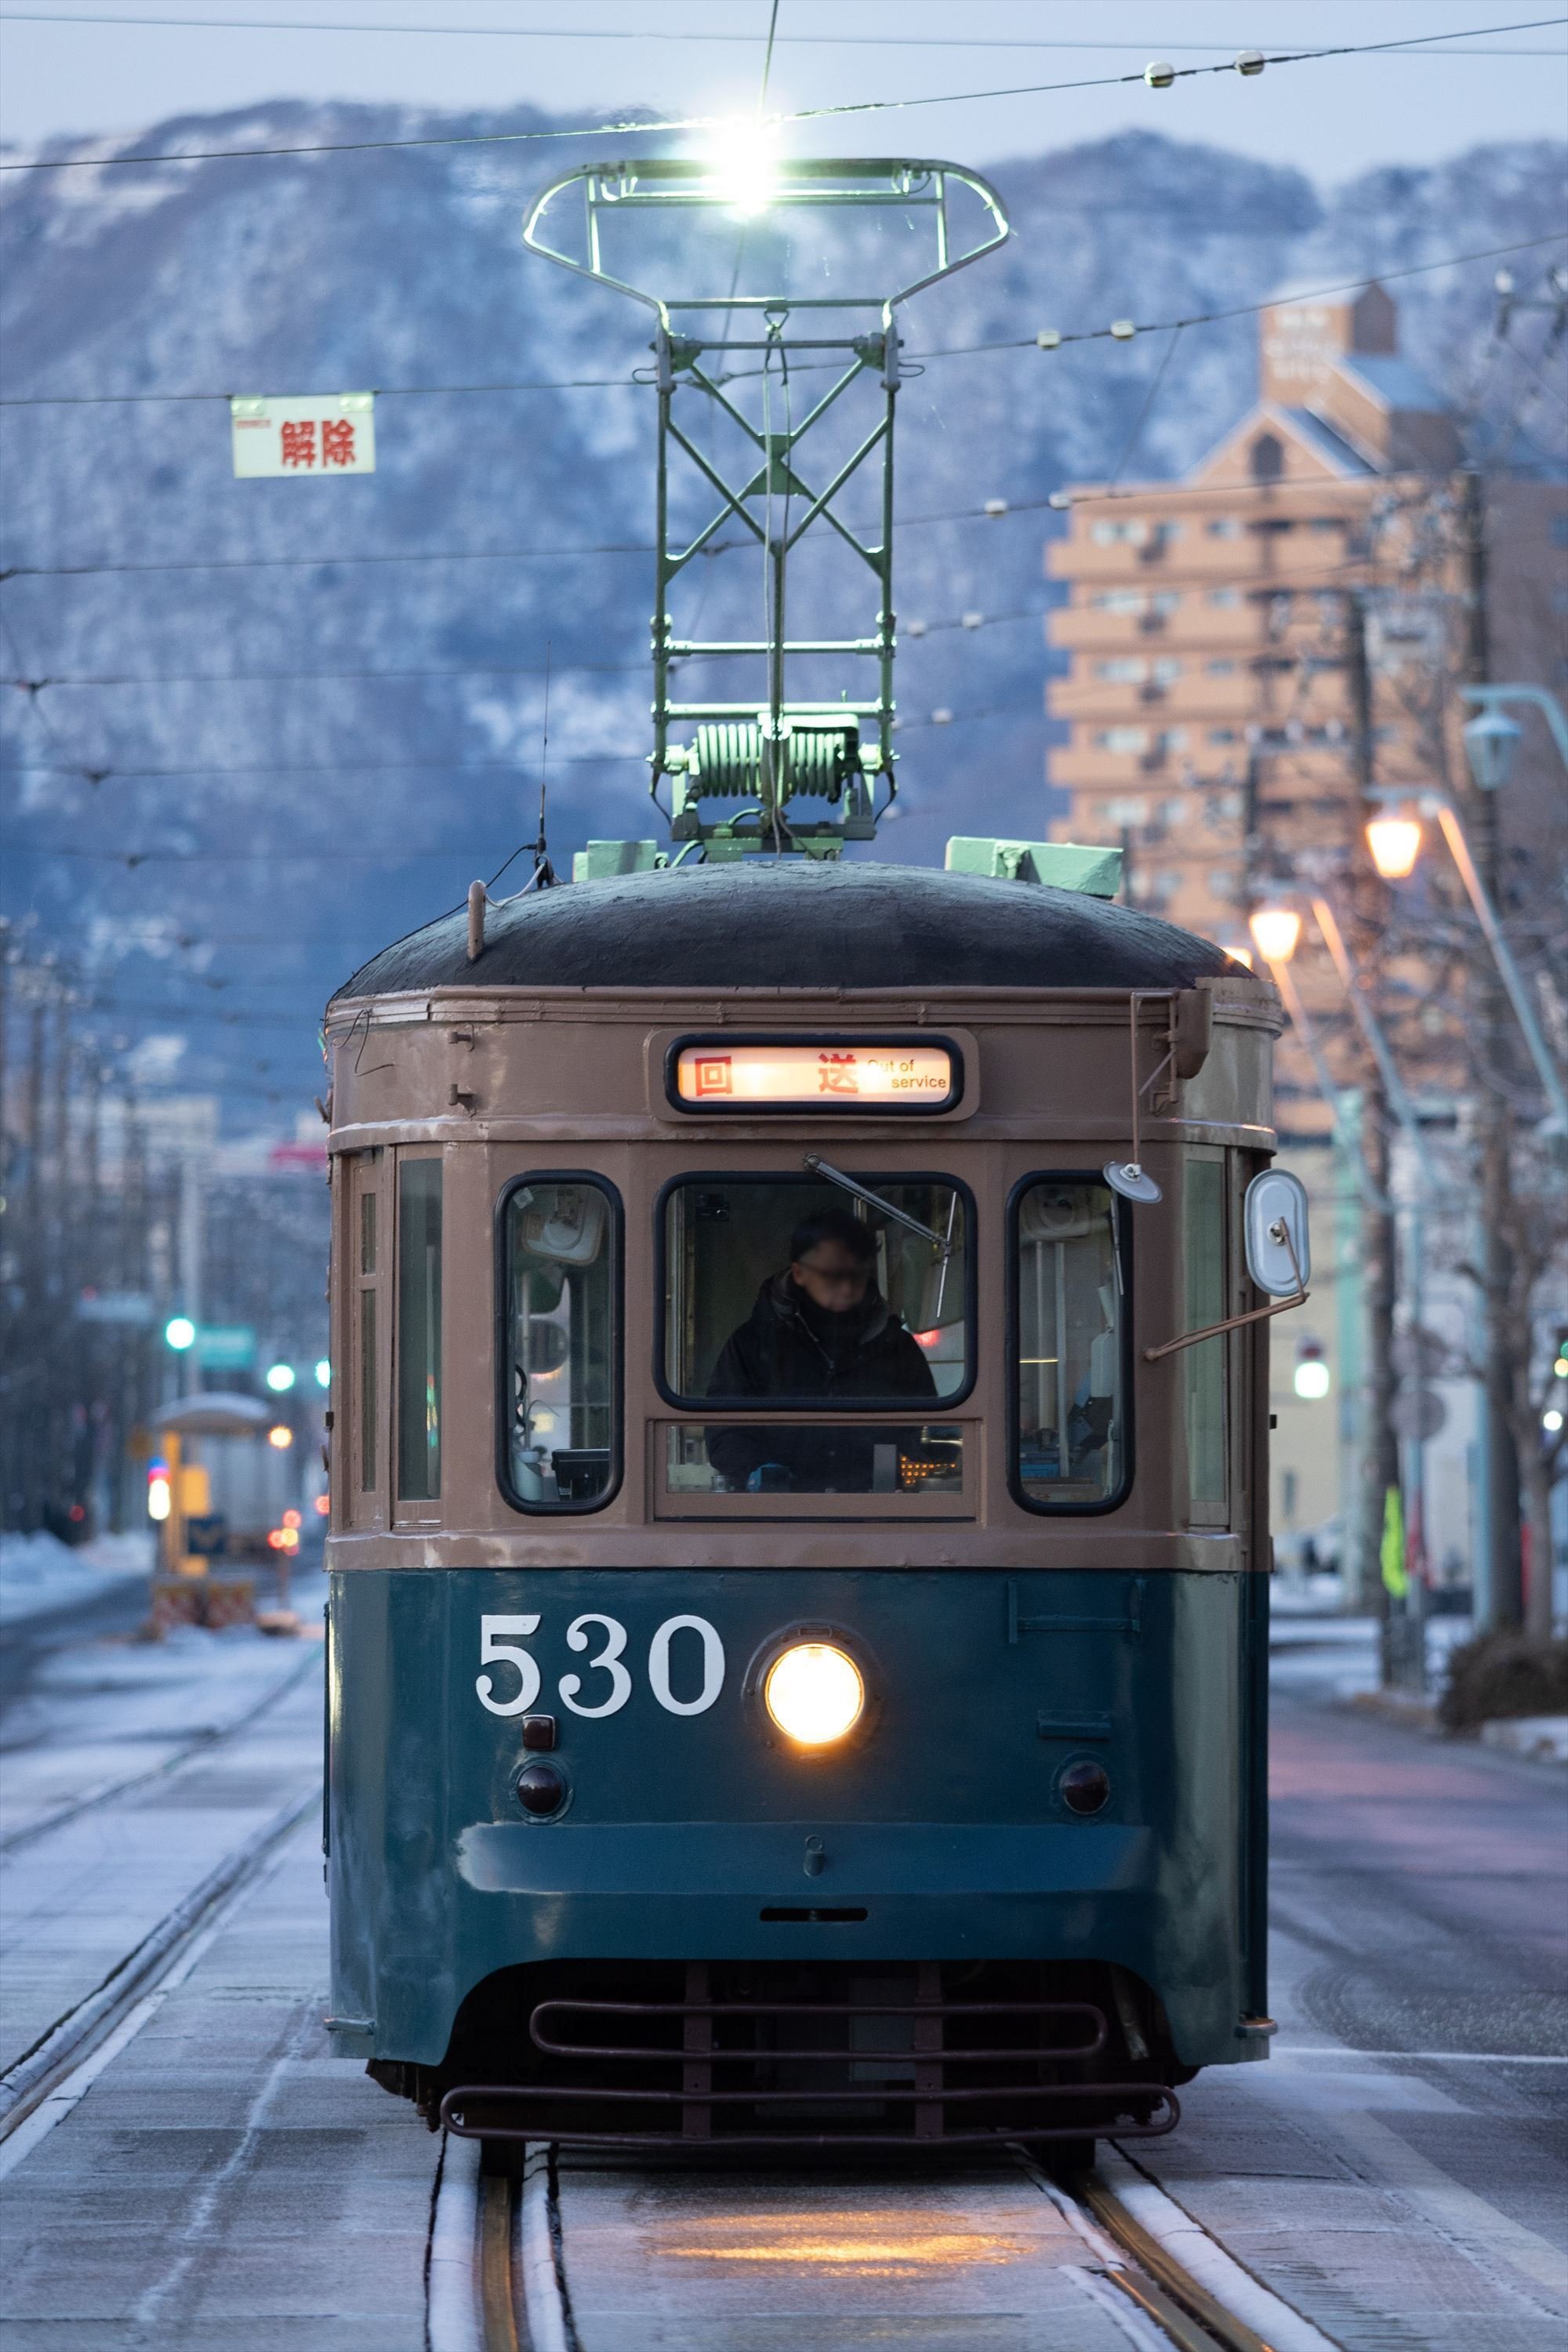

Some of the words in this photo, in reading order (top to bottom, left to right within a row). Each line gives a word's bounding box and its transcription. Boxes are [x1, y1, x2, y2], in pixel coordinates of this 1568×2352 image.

[281, 419, 357, 469] 解除
[695, 1053, 859, 1097] 回送
[891, 1075, 947, 1089] service
[899, 1059, 915, 1073] of
[475, 1613, 726, 1719] 530
